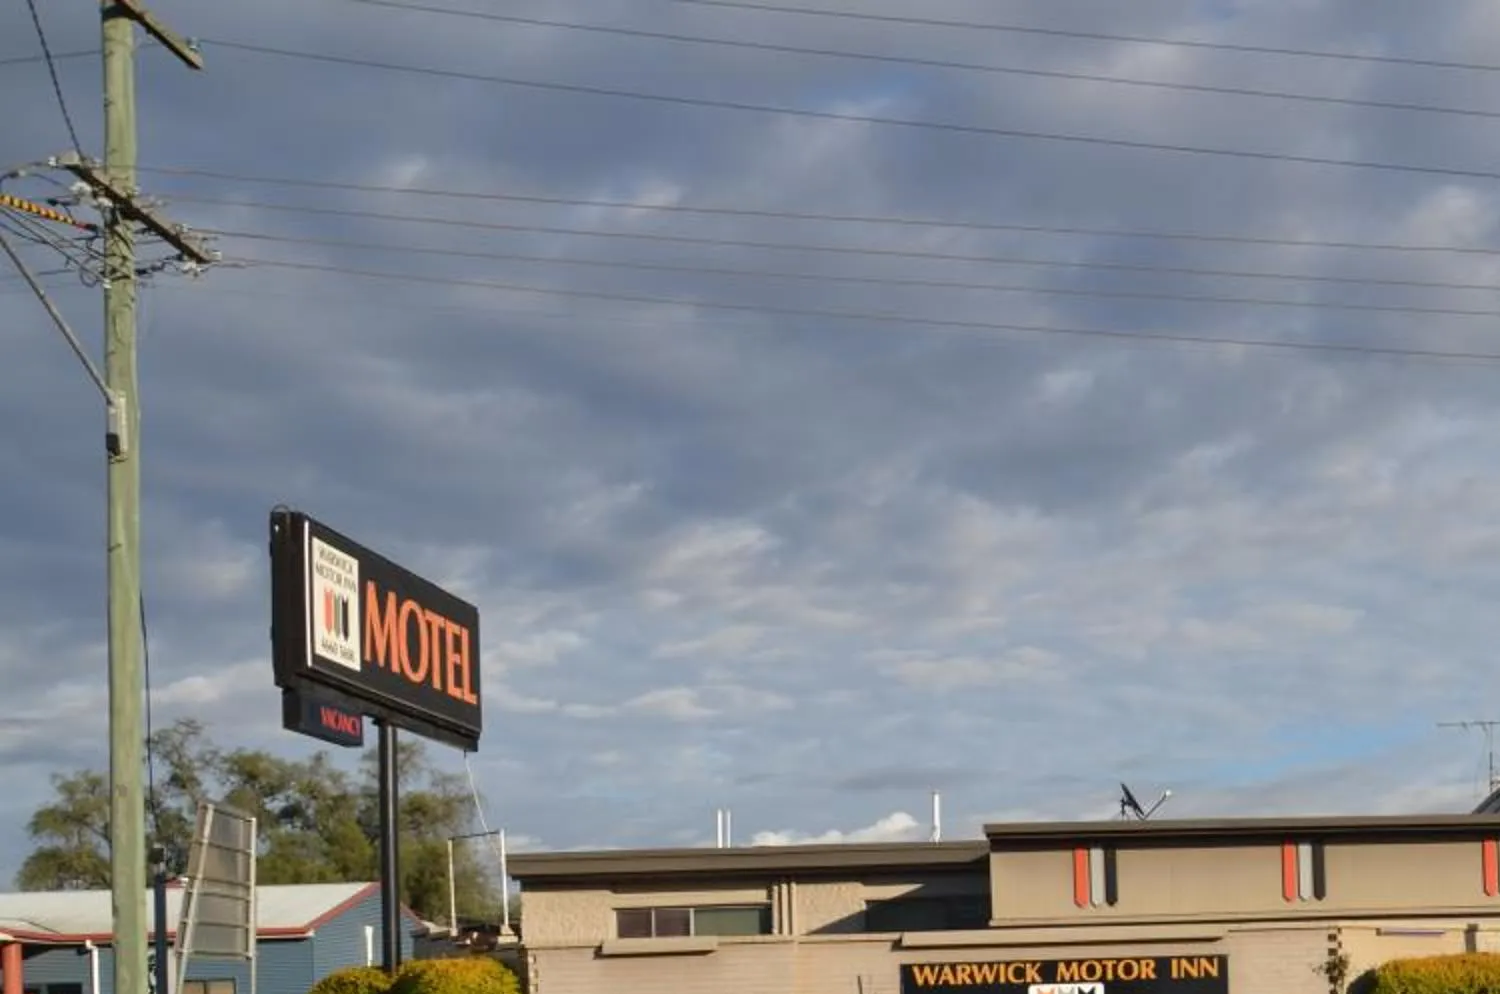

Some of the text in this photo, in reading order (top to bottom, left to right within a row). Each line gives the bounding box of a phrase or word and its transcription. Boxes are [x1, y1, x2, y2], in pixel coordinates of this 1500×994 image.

[364, 580, 478, 704] MOTEL
[912, 957, 1219, 986] WARWICK MOTOR INN
